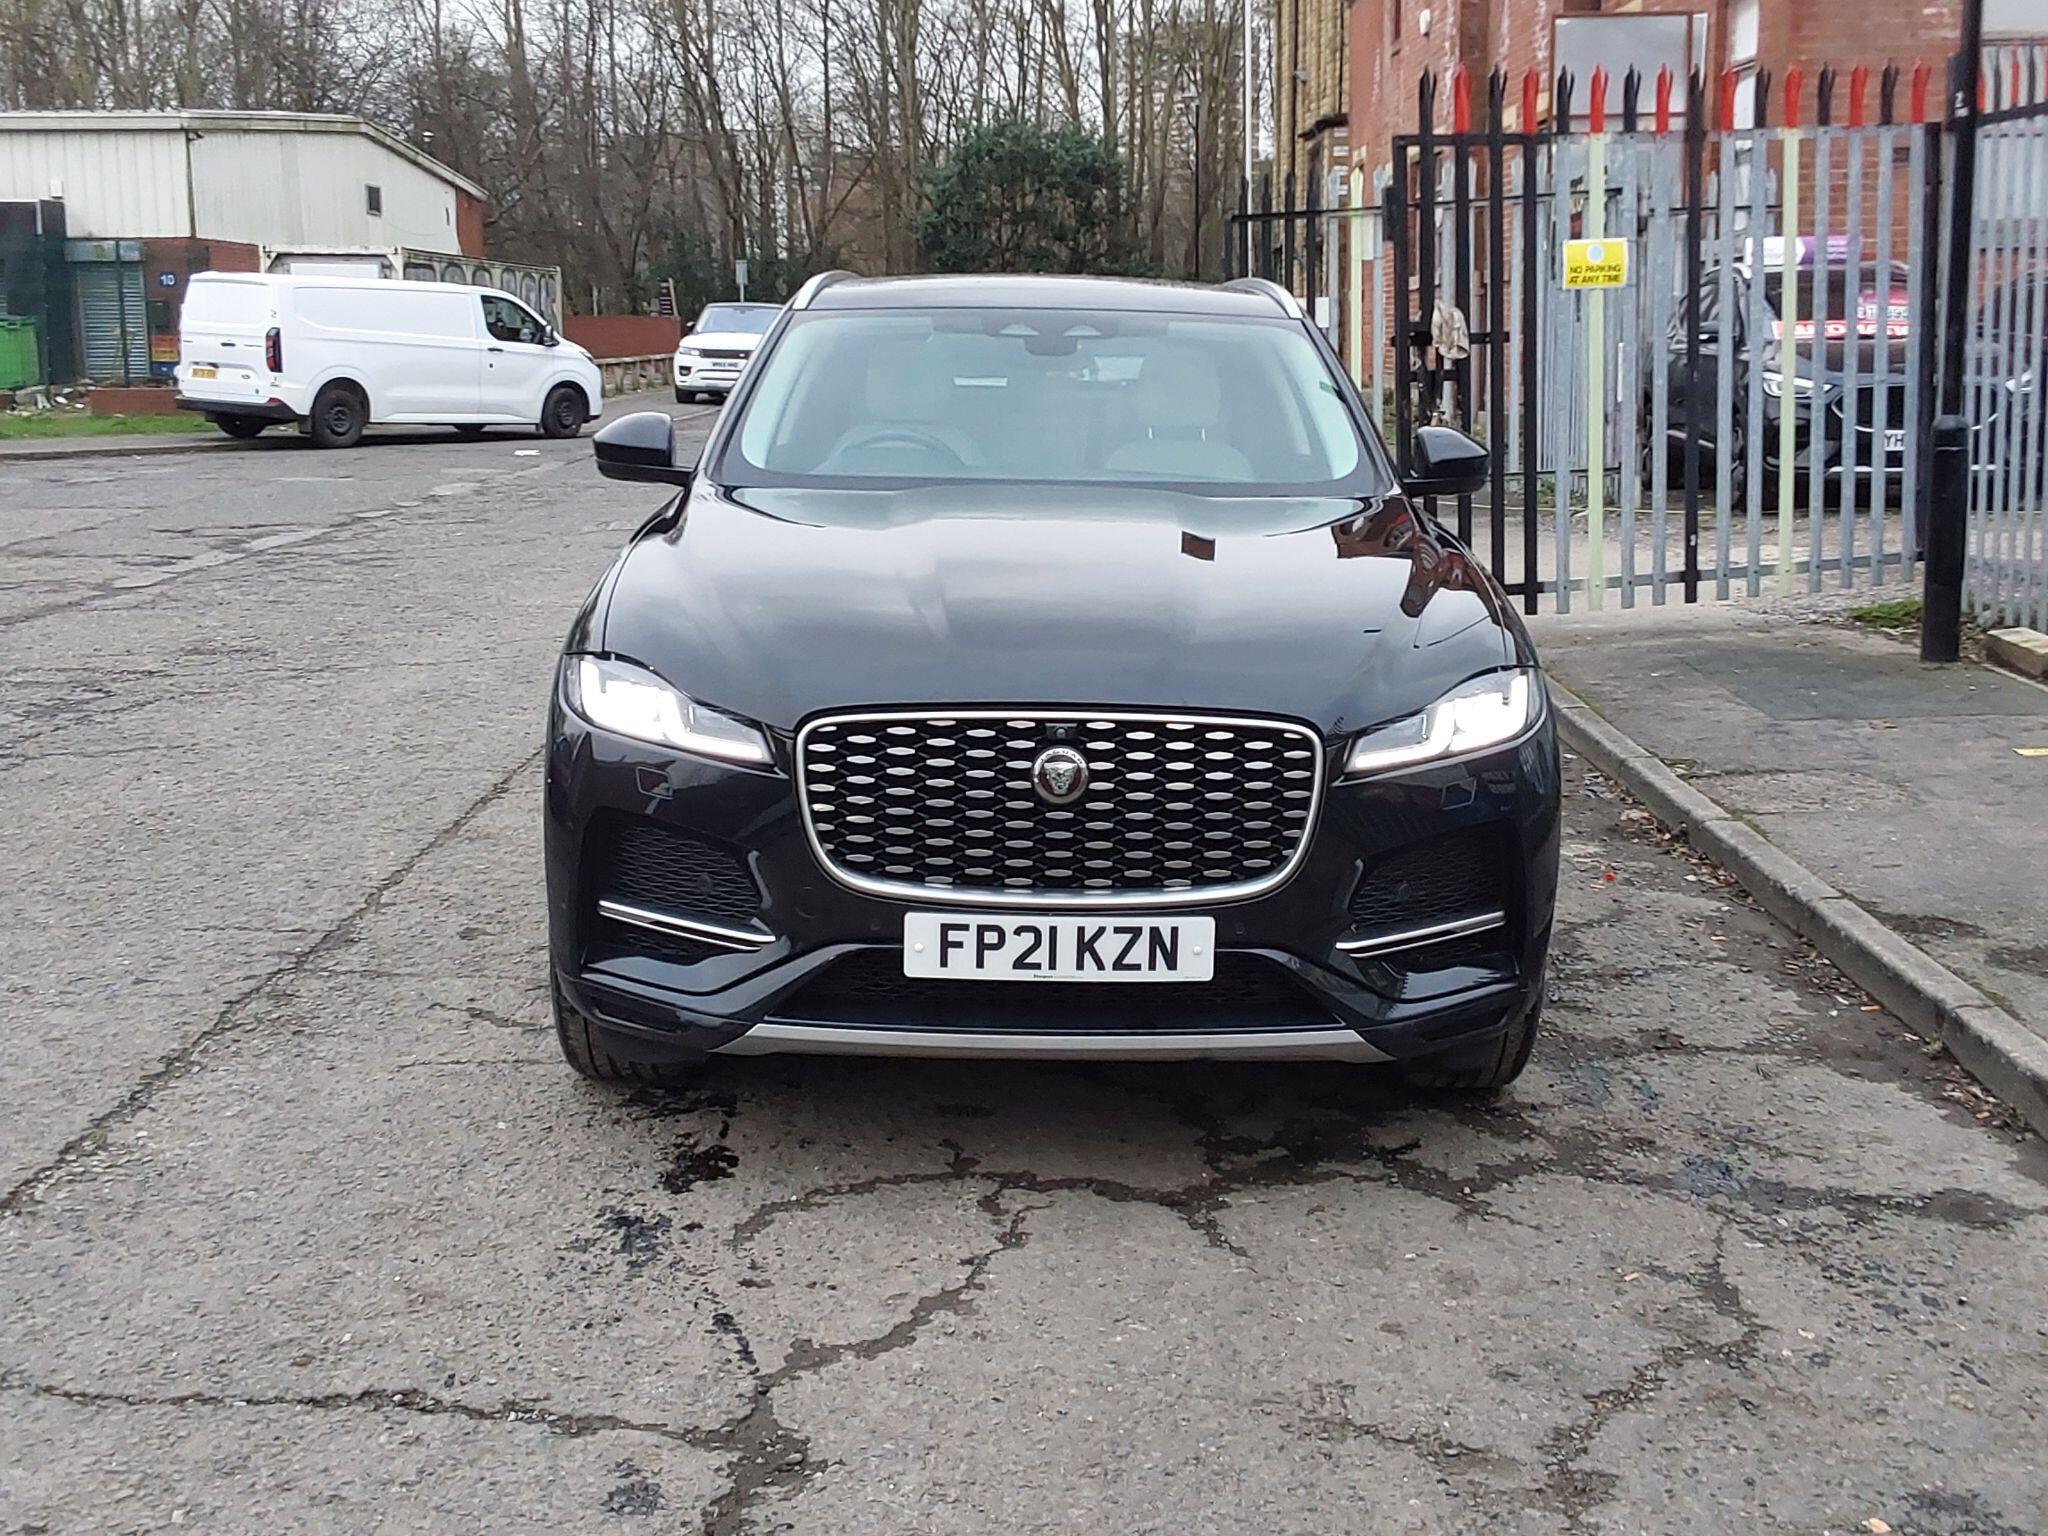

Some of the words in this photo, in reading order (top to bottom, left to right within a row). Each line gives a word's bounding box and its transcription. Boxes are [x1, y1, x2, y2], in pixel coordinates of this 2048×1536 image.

[1569, 265, 1582, 274] NO
[1585, 264, 1621, 273] PARKING
[1569, 275, 1580, 284] AT
[1582, 275, 1600, 283] ANY
[1602, 274, 1620, 283] TIME
[1040, 748, 1083, 765] JAGUAR
[940, 923, 1058, 971] FP21
[1076, 925, 1179, 971] KZN
